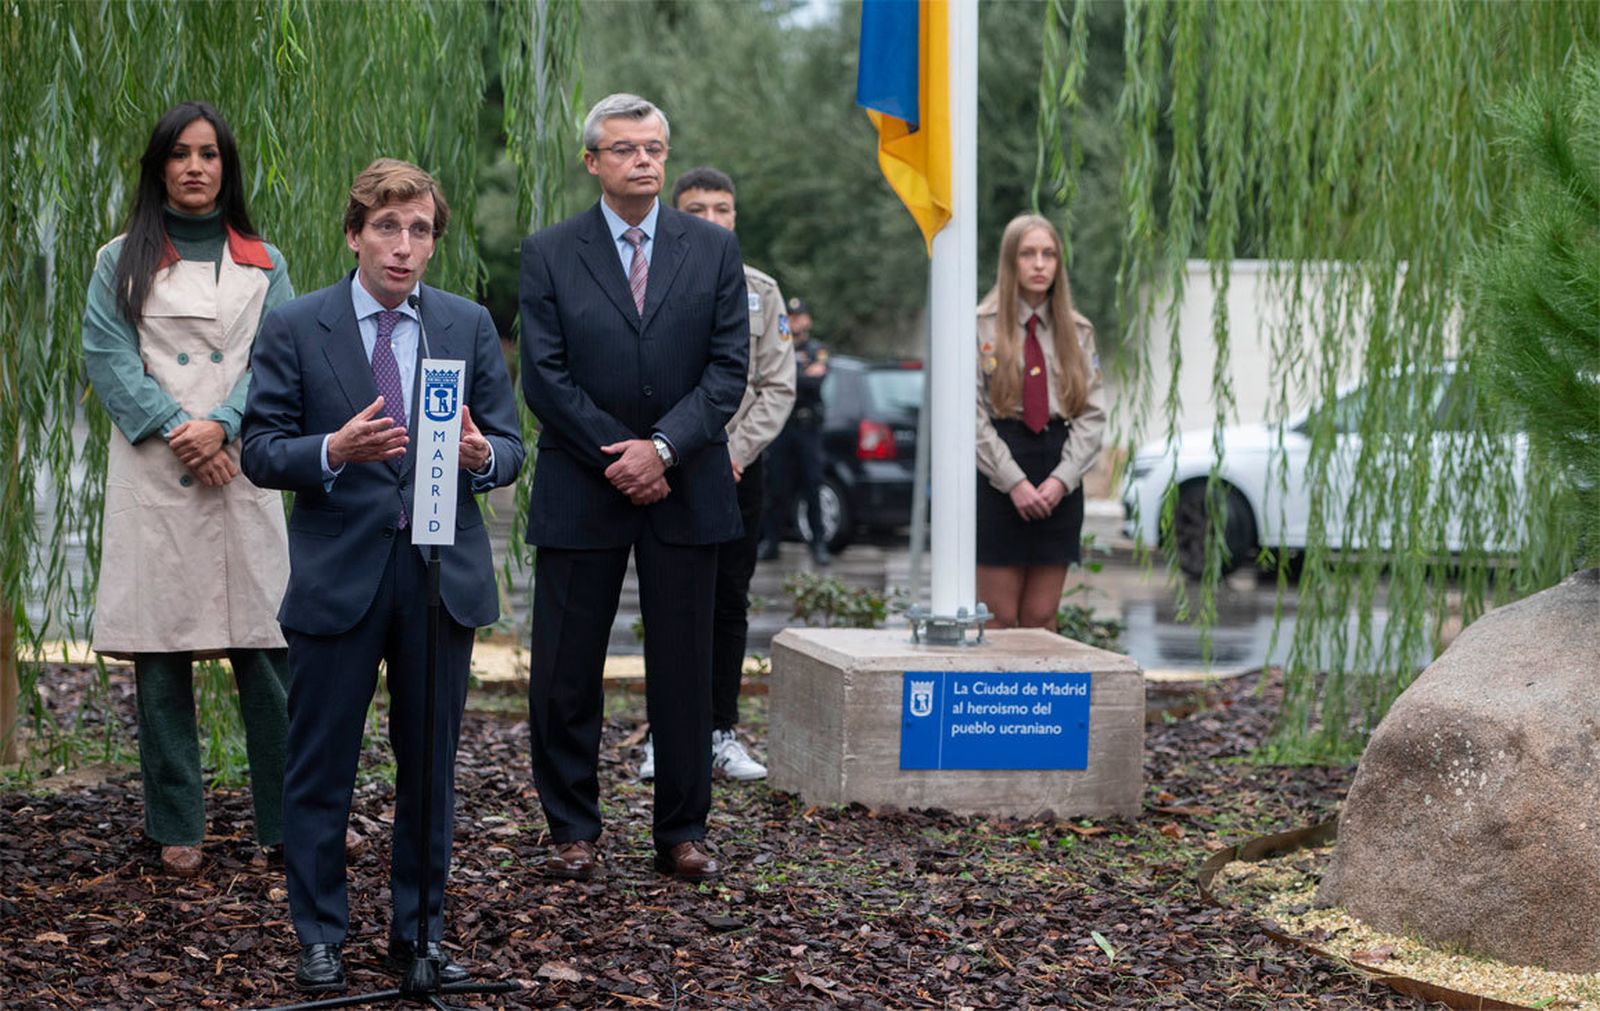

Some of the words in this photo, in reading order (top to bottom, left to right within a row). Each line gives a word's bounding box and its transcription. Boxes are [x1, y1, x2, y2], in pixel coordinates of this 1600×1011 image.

[429, 430, 445, 533] MADRID
[953, 681, 968, 695] La
[972, 681, 1018, 695] Ciudad
[1022, 682, 1038, 695] de
[1042, 682, 1087, 696] Madrid
[952, 701, 963, 714] al
[967, 701, 1028, 715] heroismo
[1032, 702, 1052, 715] del
[951, 721, 995, 737] pueblo
[999, 721, 1062, 735] ucraniano
